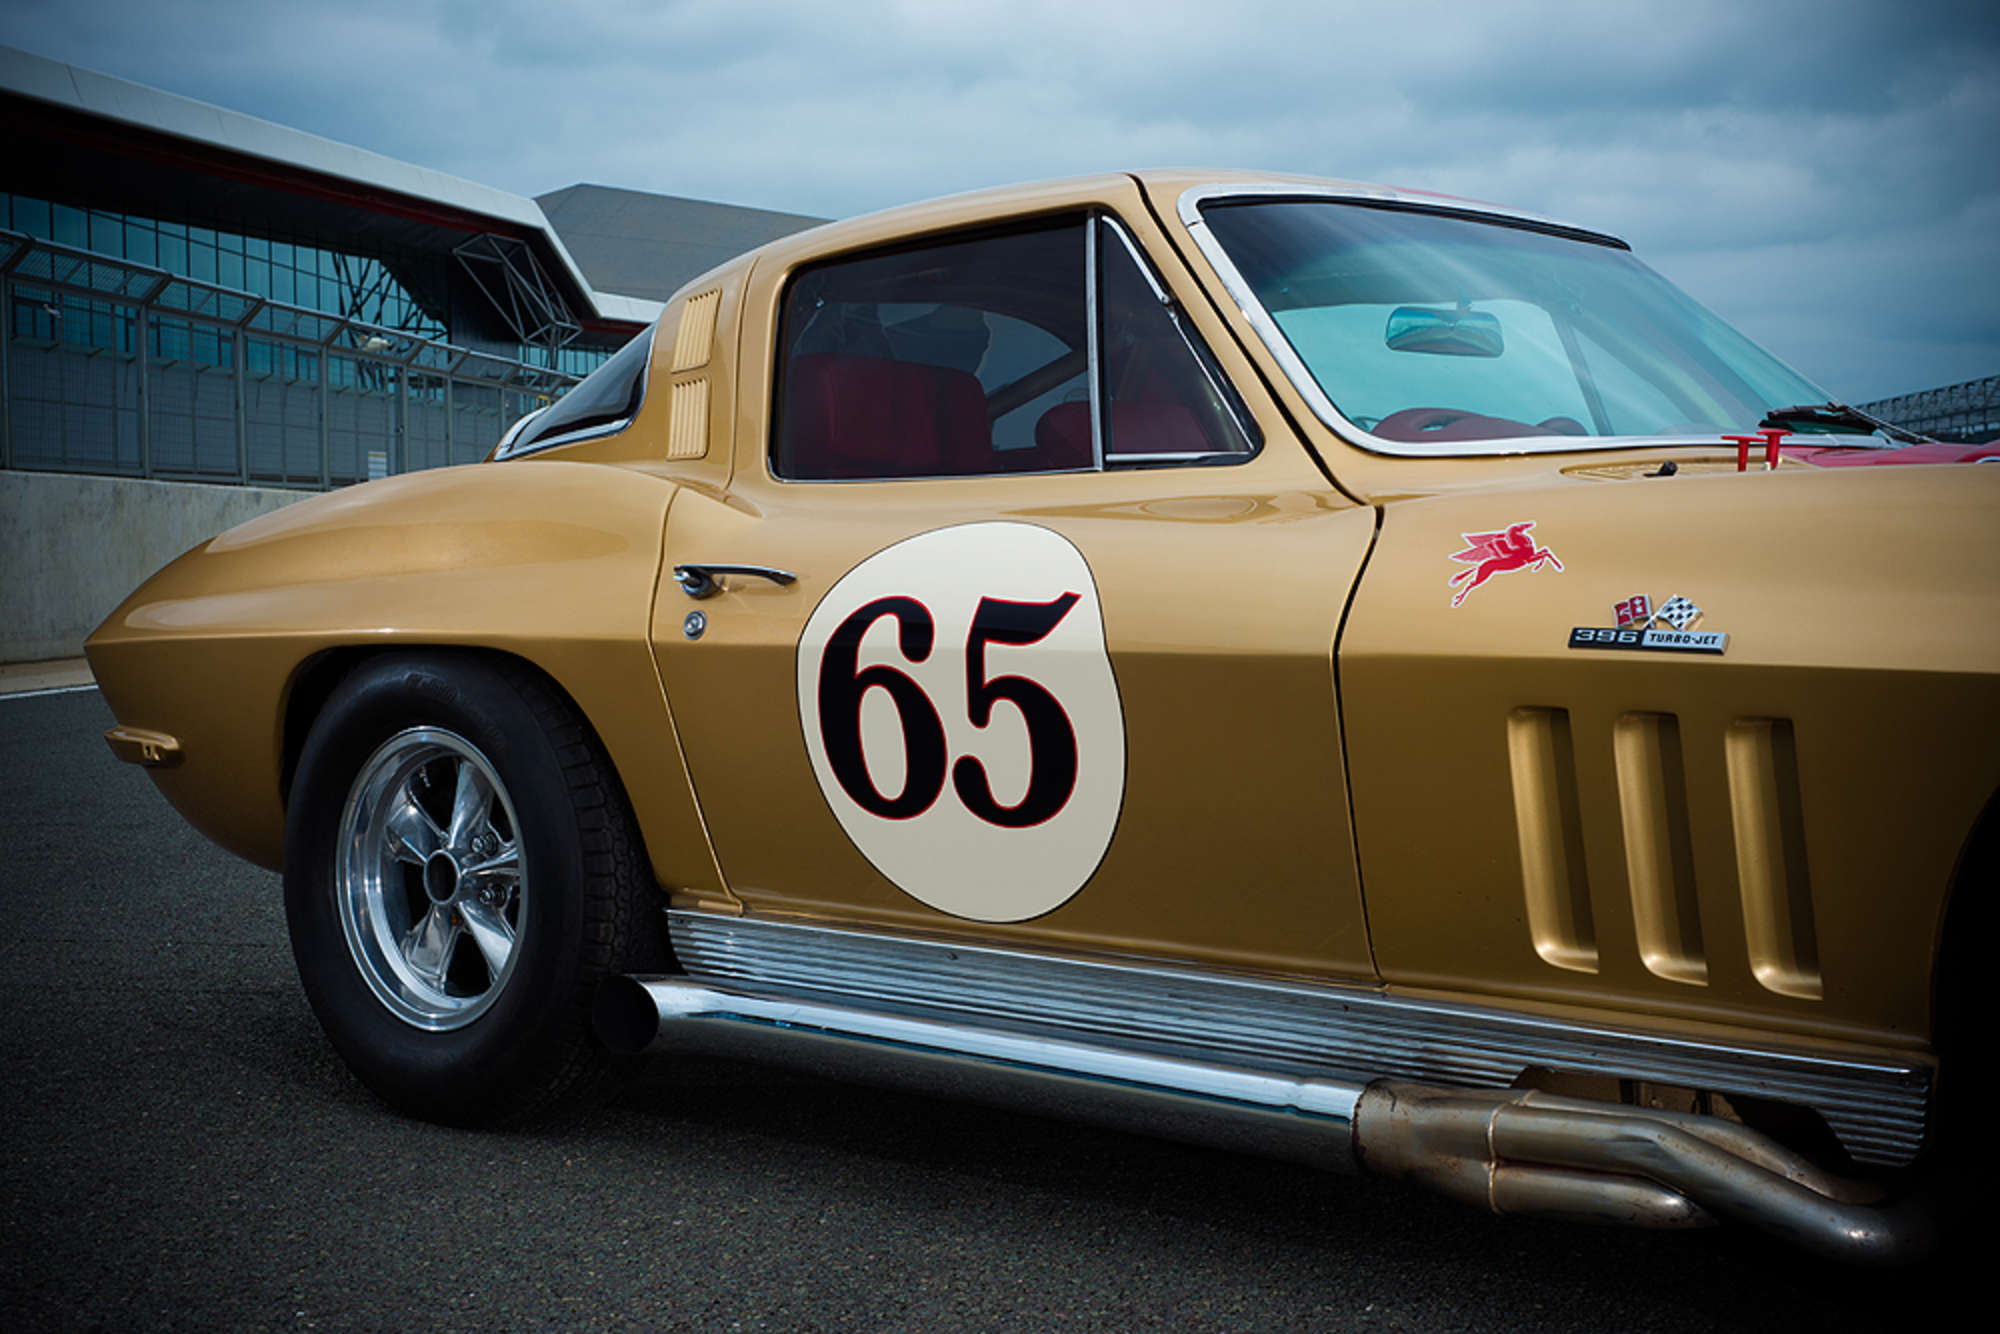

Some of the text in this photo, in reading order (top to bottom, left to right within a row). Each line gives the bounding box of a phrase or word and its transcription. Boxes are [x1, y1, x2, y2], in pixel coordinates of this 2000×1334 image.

[1575, 629, 1719, 646] 396 TURBO-JET
[818, 592, 1080, 828] 65
